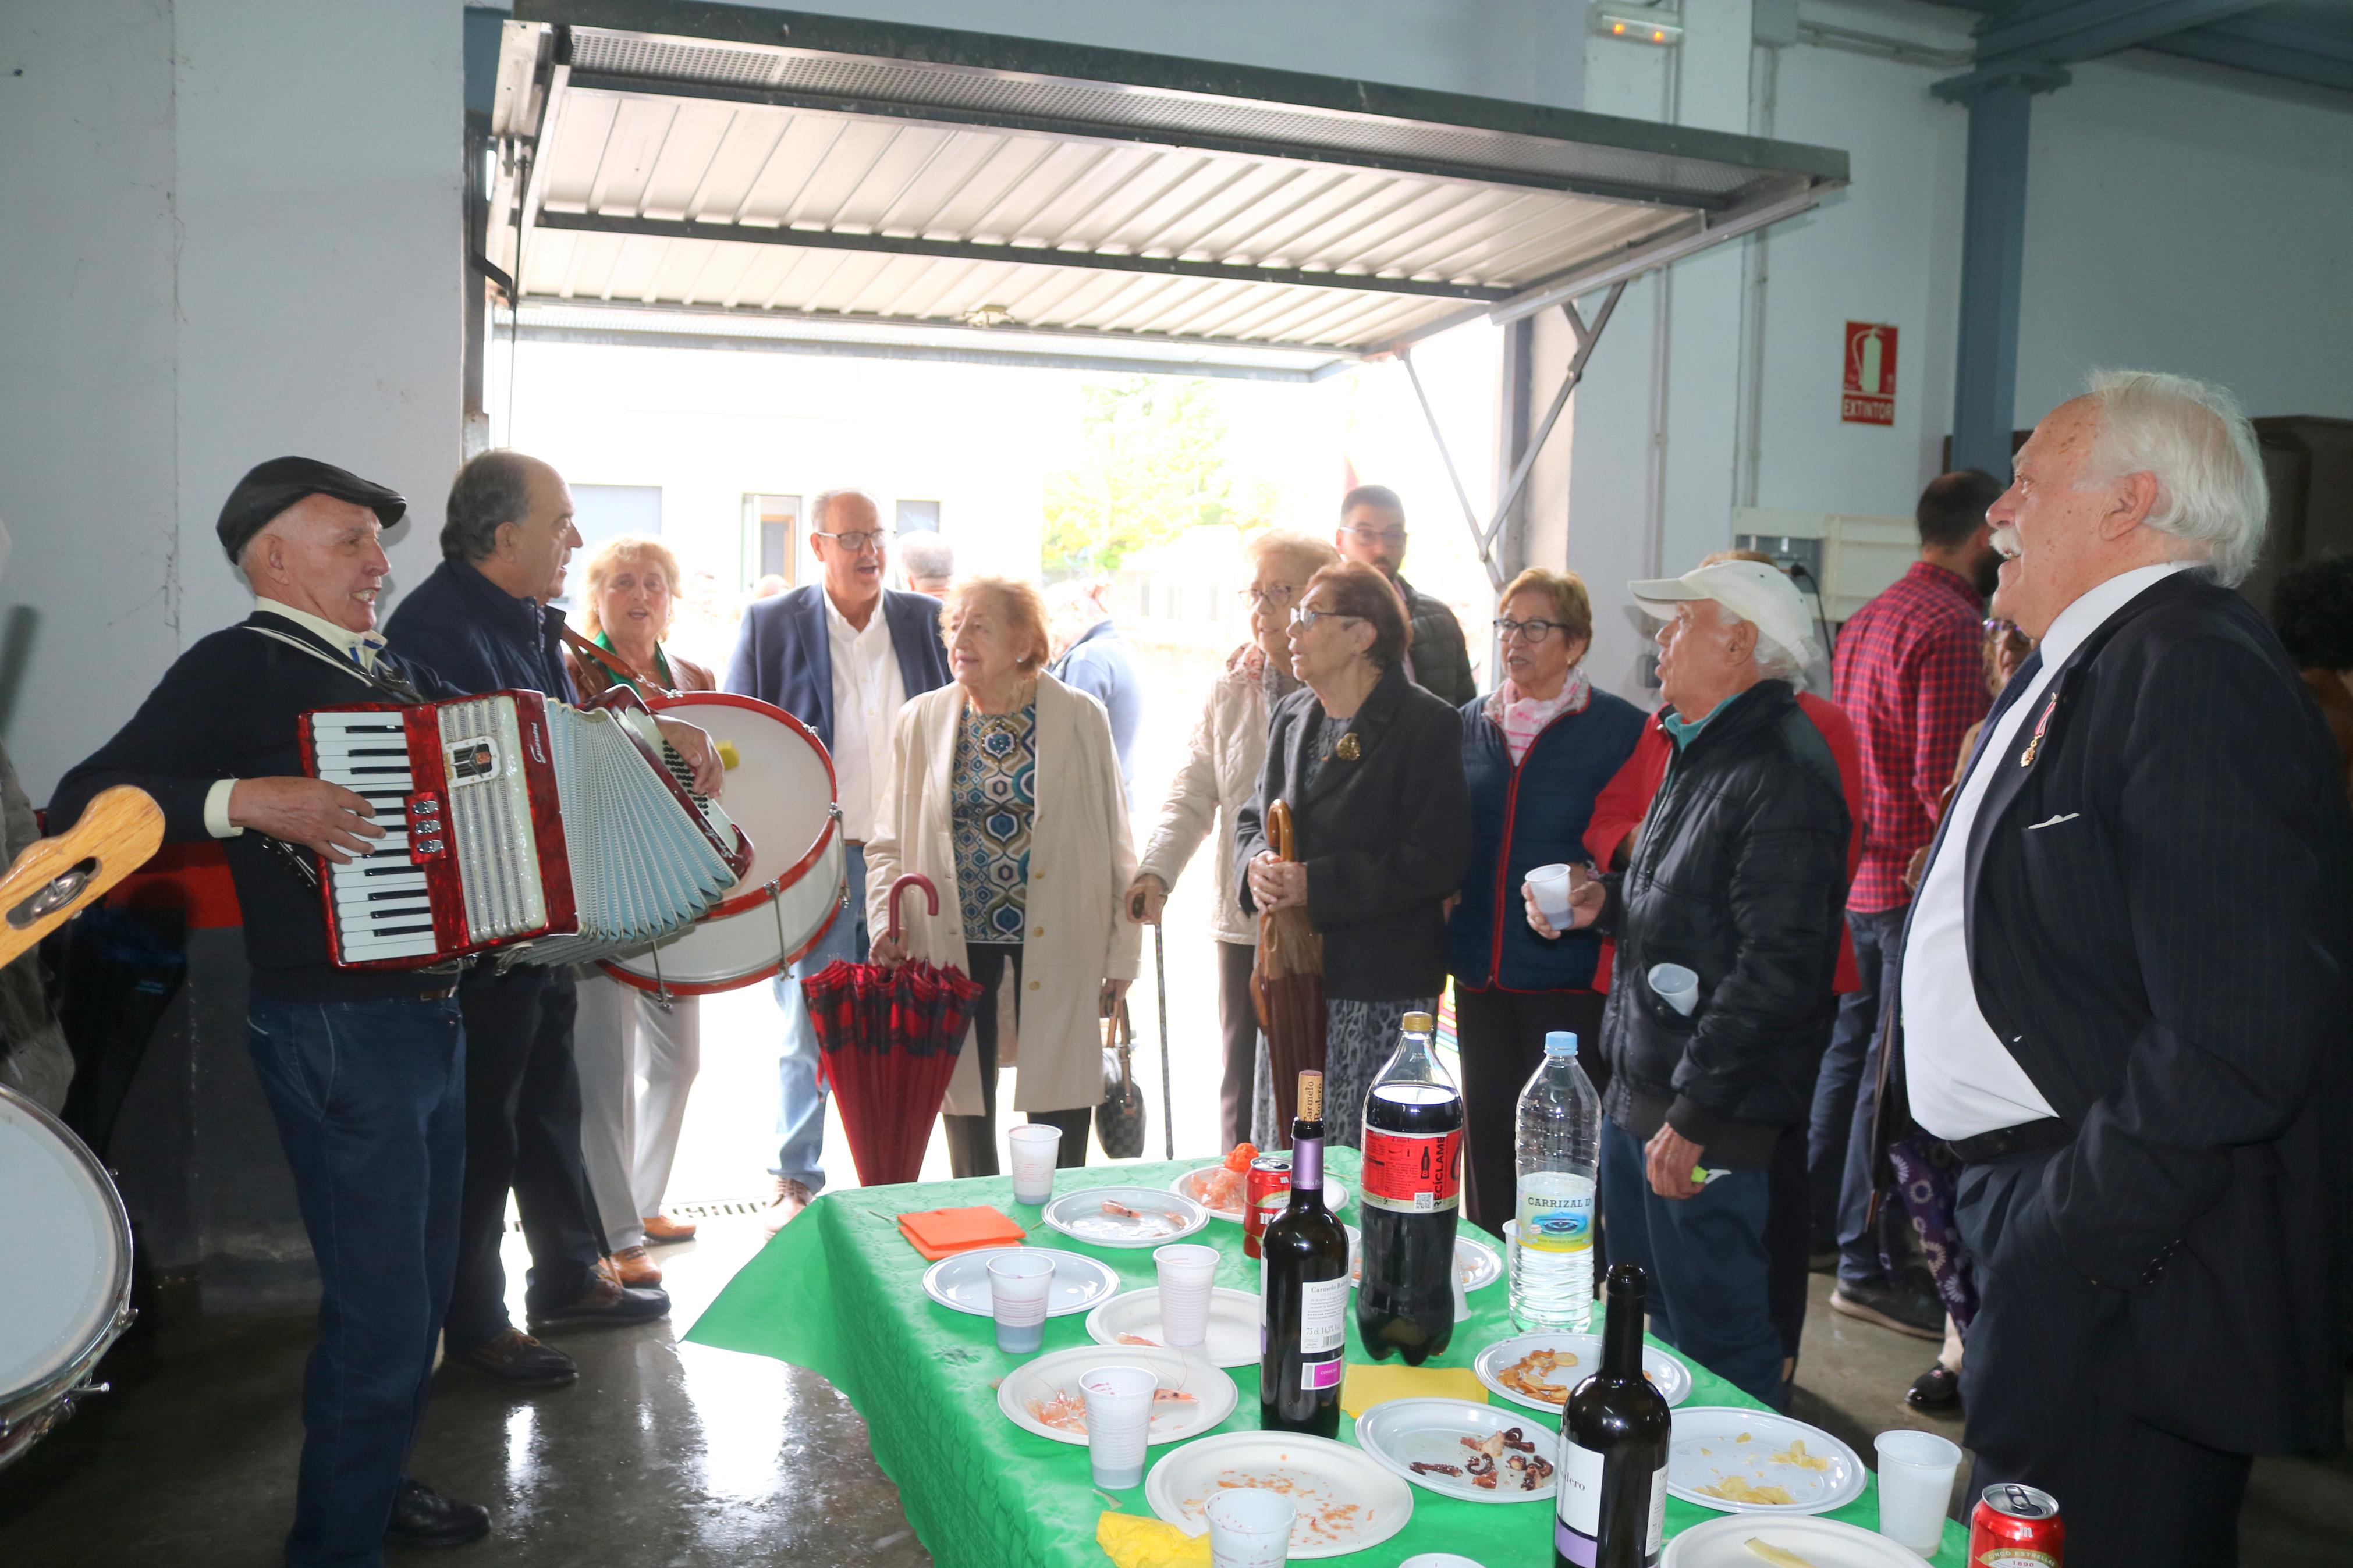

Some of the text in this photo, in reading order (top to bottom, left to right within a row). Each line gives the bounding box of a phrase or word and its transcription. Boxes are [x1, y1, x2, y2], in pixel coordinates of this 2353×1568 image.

[1843, 399, 1893, 420] EXTINTOR
[1314, 1083, 1322, 1121] Rodero
[1433, 1137, 1445, 1209] RECÍCLAME
[1528, 1197, 1583, 1208] CARRIZAL
[1311, 1283, 1336, 1293] Carmelo
[1988, 1551, 2012, 1560] CINCO
[2014, 1551, 2056, 1567] ESTRELLAS
